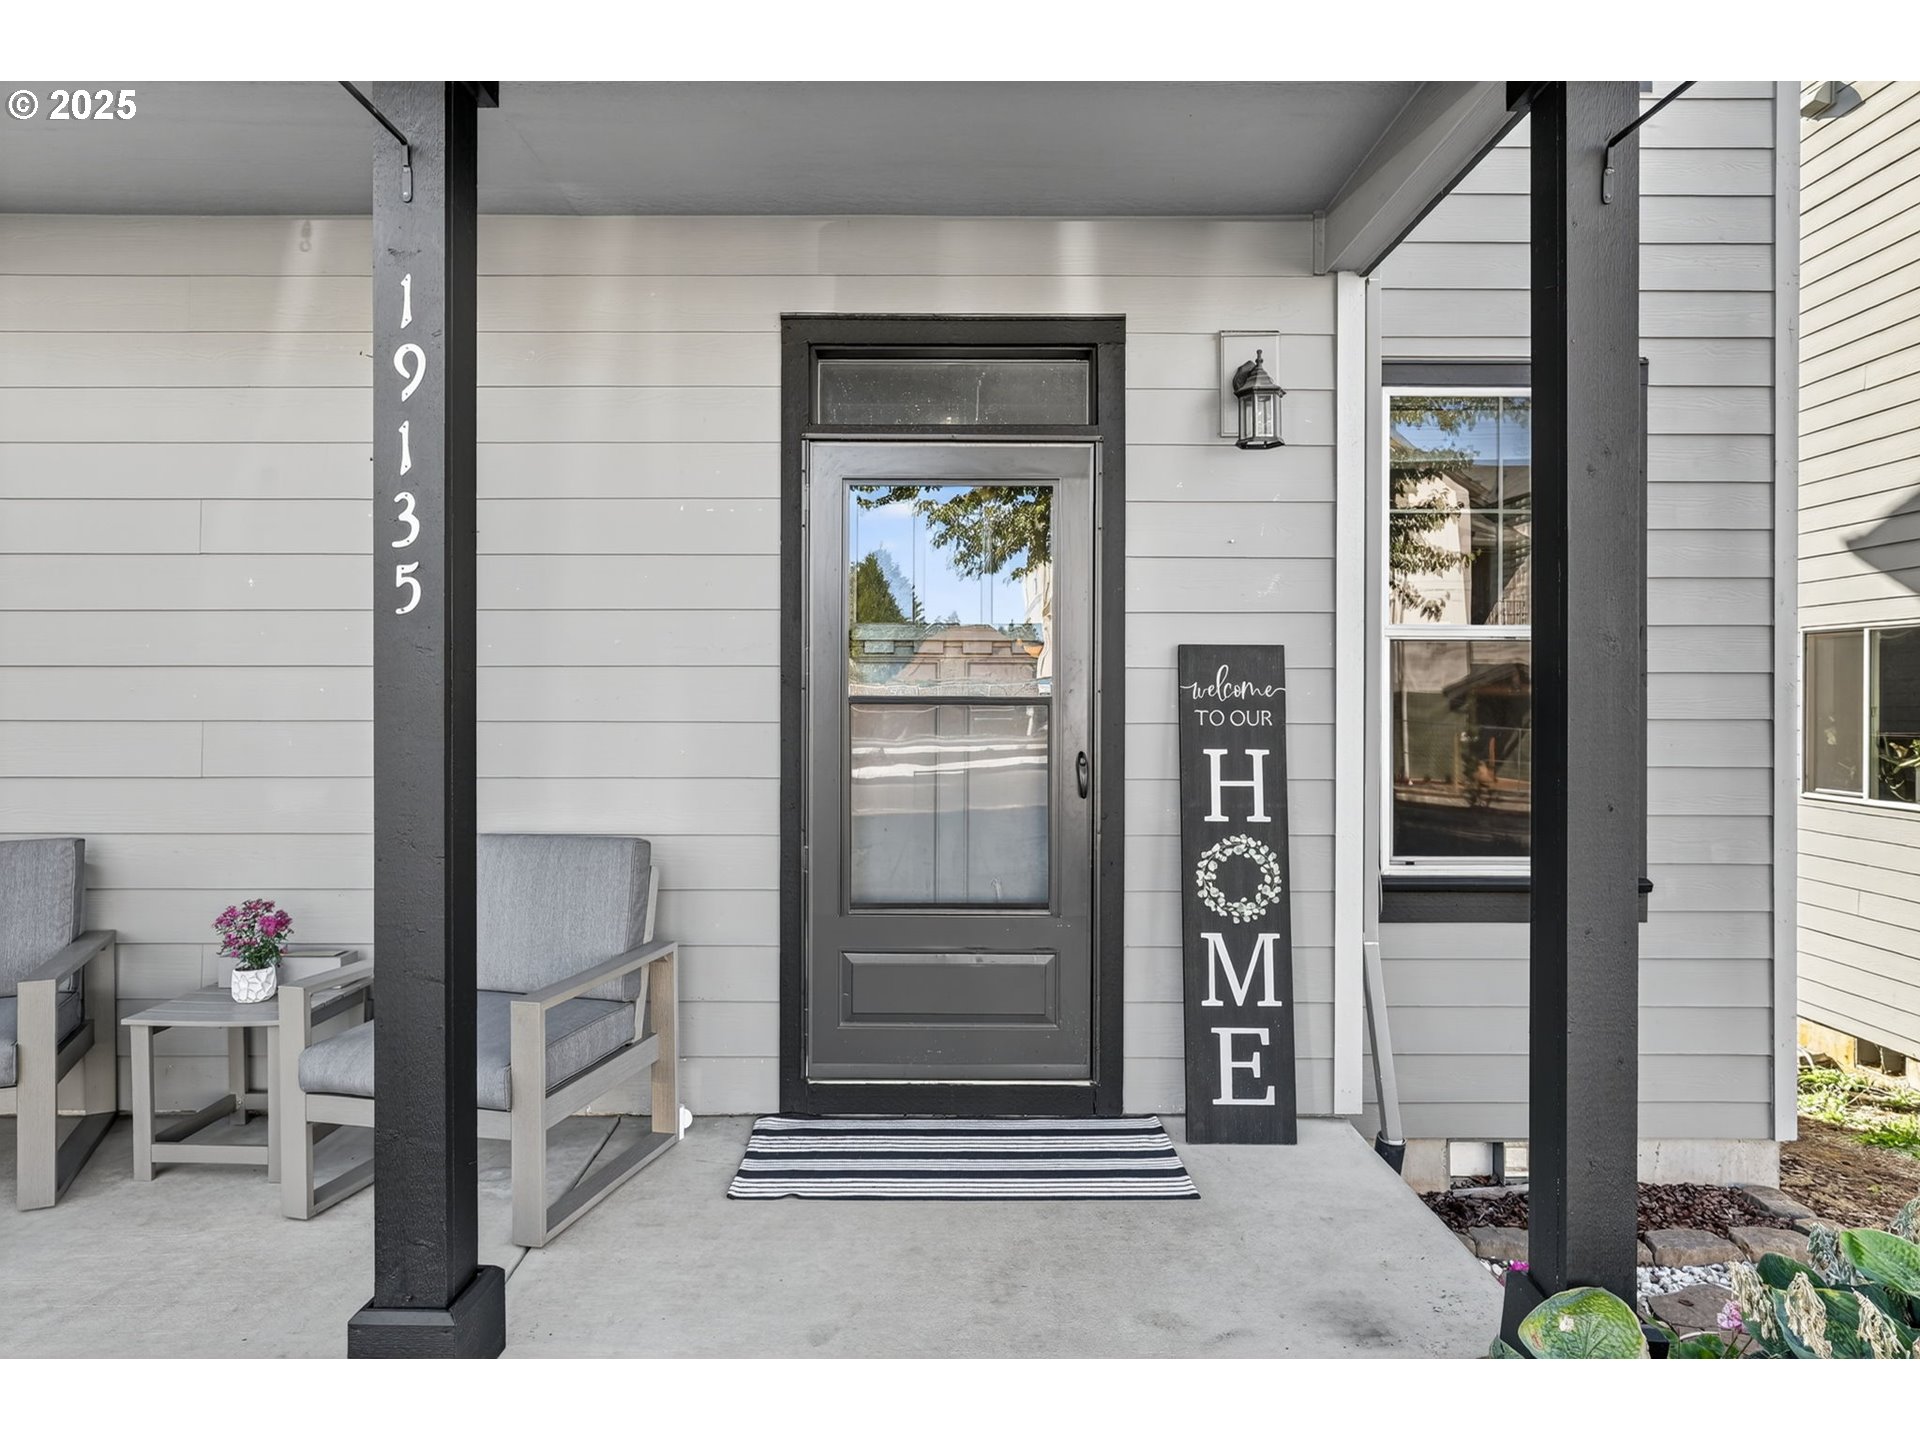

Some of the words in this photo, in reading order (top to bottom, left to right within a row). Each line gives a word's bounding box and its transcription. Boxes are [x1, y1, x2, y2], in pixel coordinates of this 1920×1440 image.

[391, 272, 427, 615] 19135
[1180, 664, 1286, 701] welcome
[1194, 709, 1225, 727] TO
[1229, 709, 1273, 727] OUR
